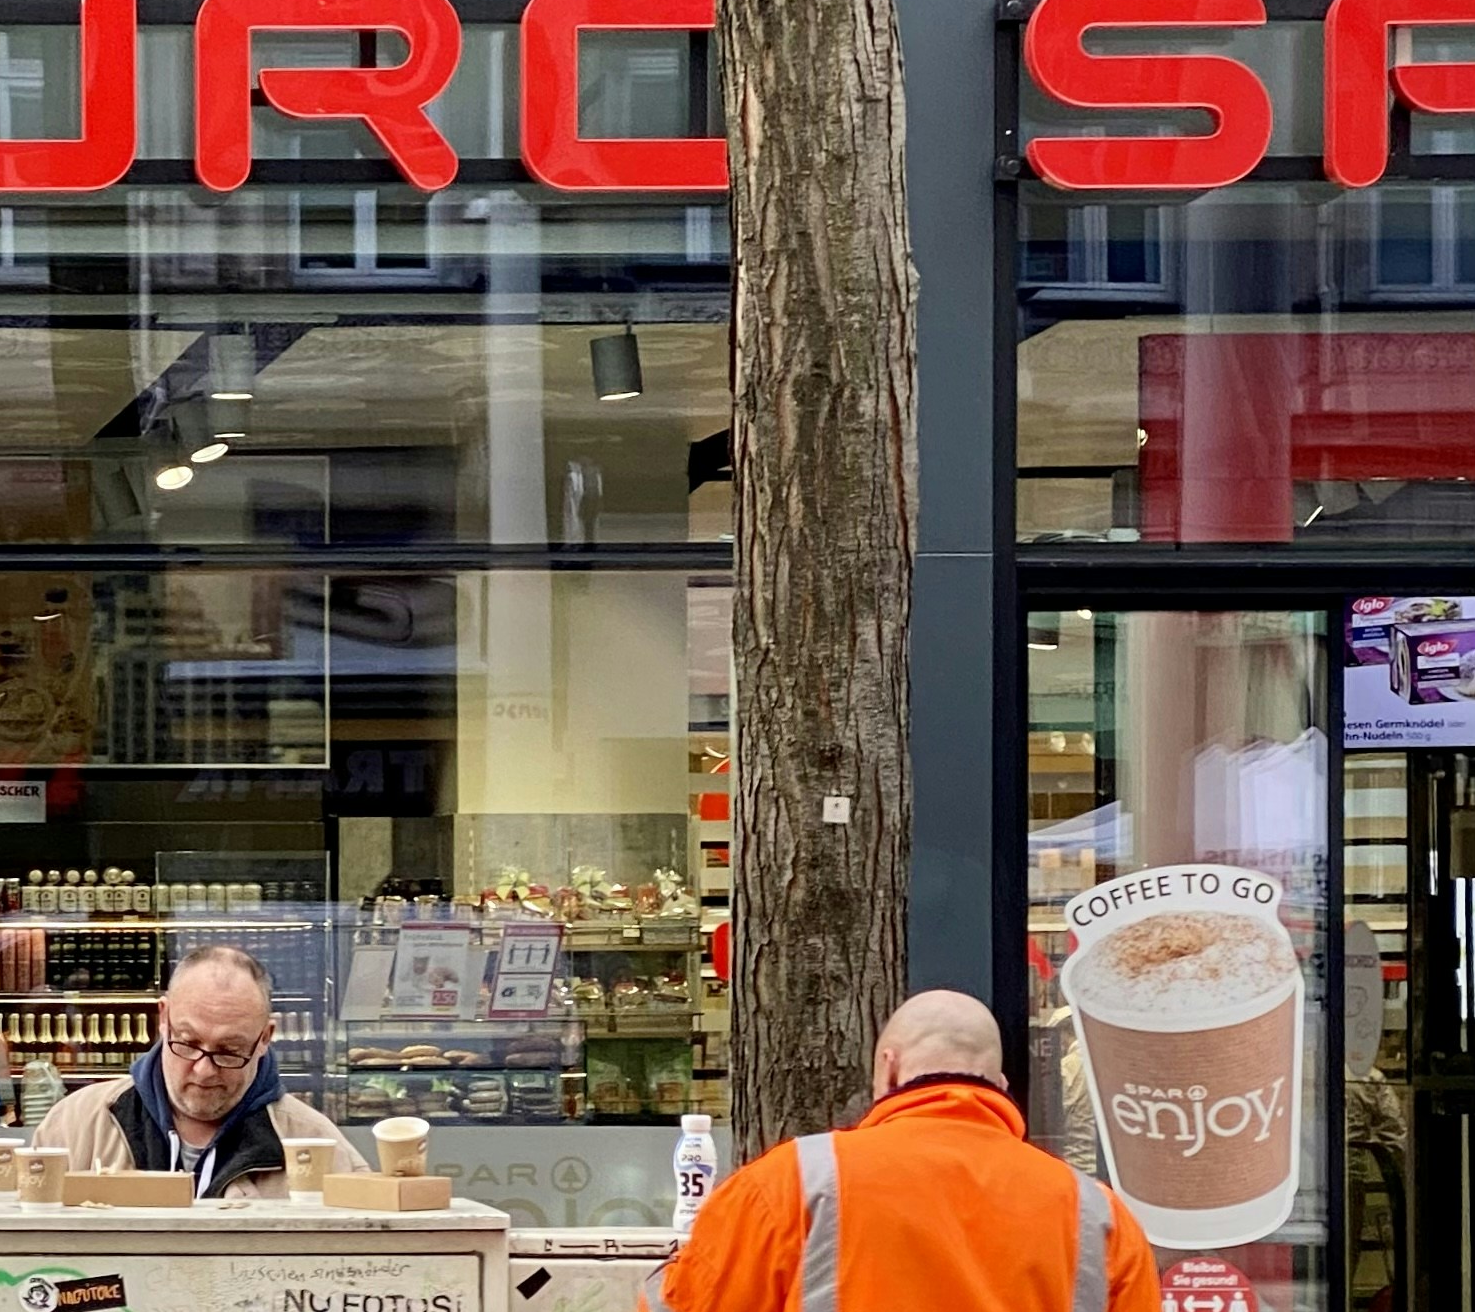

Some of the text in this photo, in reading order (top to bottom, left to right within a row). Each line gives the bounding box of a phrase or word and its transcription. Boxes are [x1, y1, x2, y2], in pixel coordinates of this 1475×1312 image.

[1359, 599, 1385, 614] iglo
[1424, 641, 1450, 655] iglo
[1375, 718, 1445, 729] Germknödel
[1072, 873, 1275, 927] COFFEE TO GO
[1124, 1082, 1184, 1099] SPAR
[1111, 1076, 1286, 1158] enjoy.
[679, 1171, 705, 1198] 35
[1182, 1261, 1227, 1274] Bleiben
[1172, 1274, 1191, 1286] Sie
